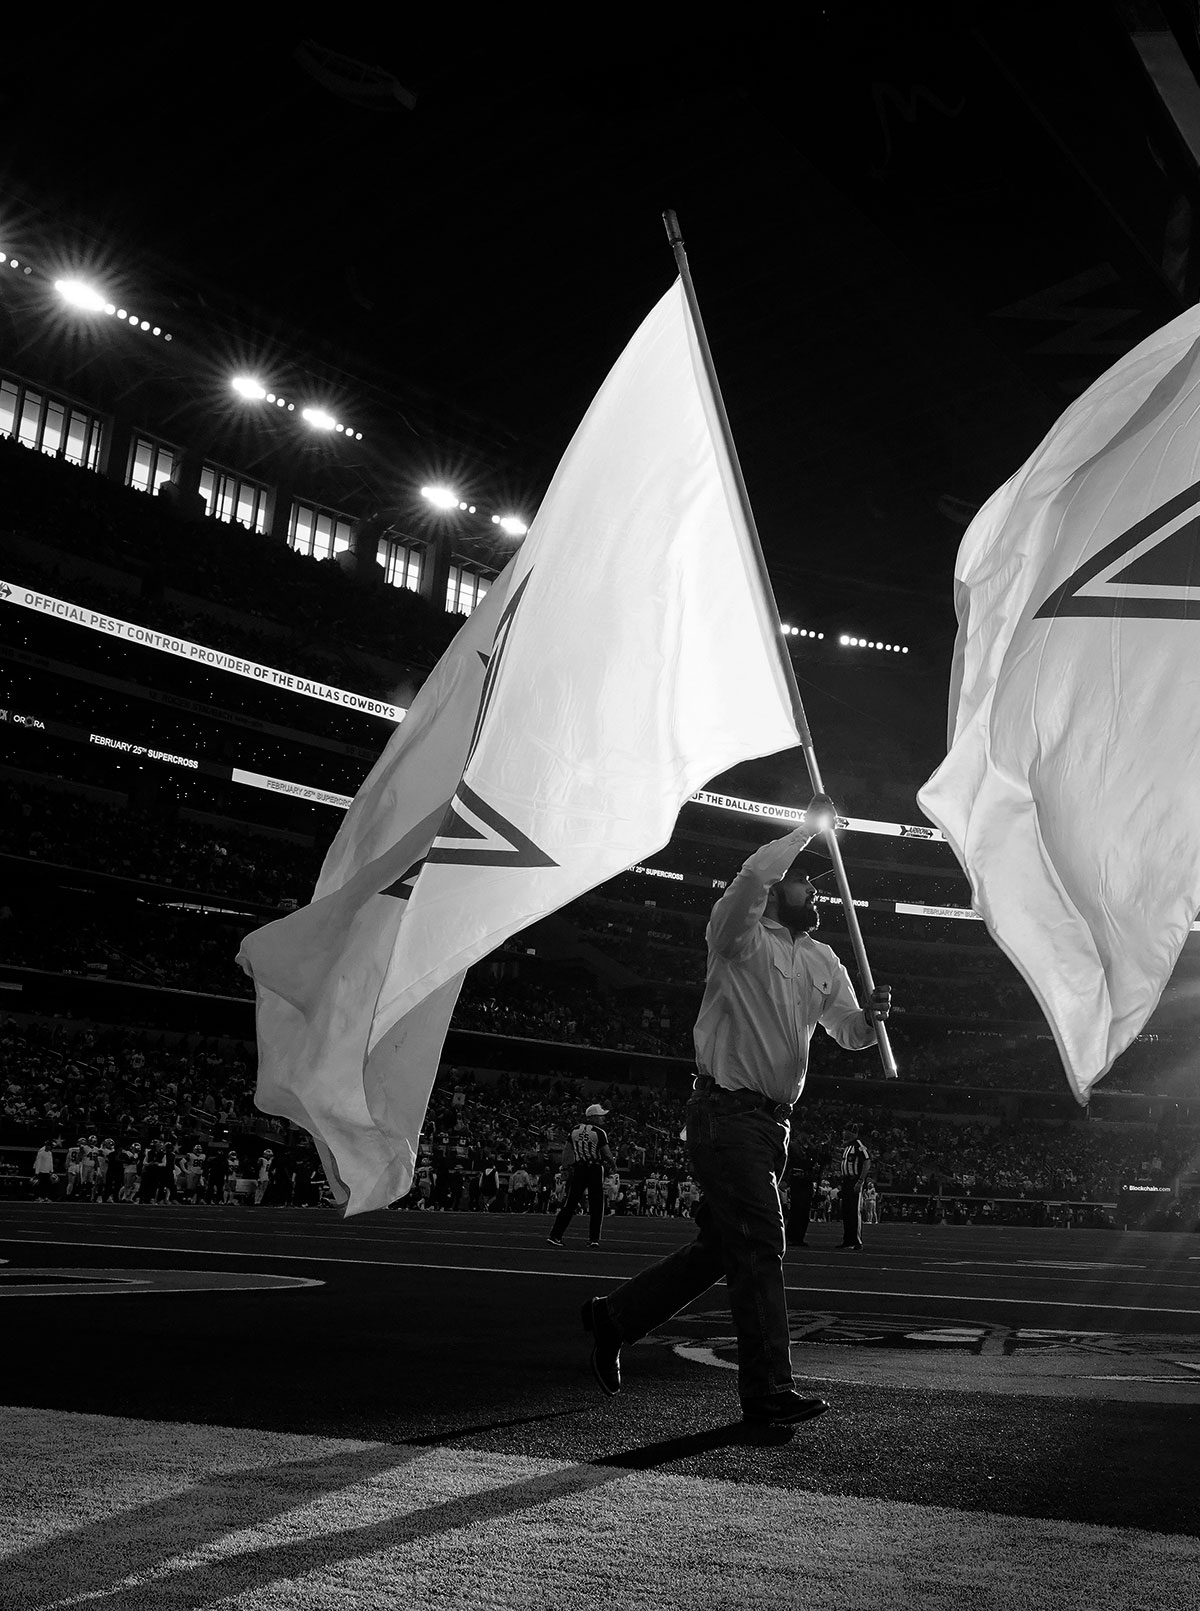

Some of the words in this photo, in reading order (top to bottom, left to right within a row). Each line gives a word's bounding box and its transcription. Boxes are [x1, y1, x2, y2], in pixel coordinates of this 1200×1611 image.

[24, 593, 86, 623] OFFICIAL
[90, 614, 124, 634] PEST
[127, 627, 187, 655] CONTROL
[190, 646, 251, 674] PROVIDER
[253, 667, 270, 680] OF
[272, 672, 294, 688] THE
[296, 680, 340, 702] DALLAS
[342, 694, 395, 718] COWBOYS
[89, 733, 132, 752] FEBRUARY
[147, 748, 199, 769] SUPERCROSS
[266, 779, 304, 796] FEBRUARY
[707, 794, 723, 805] THE
[726, 799, 760, 813] DALLAS
[1129, 1185, 1171, 1193] Blockchain.com
